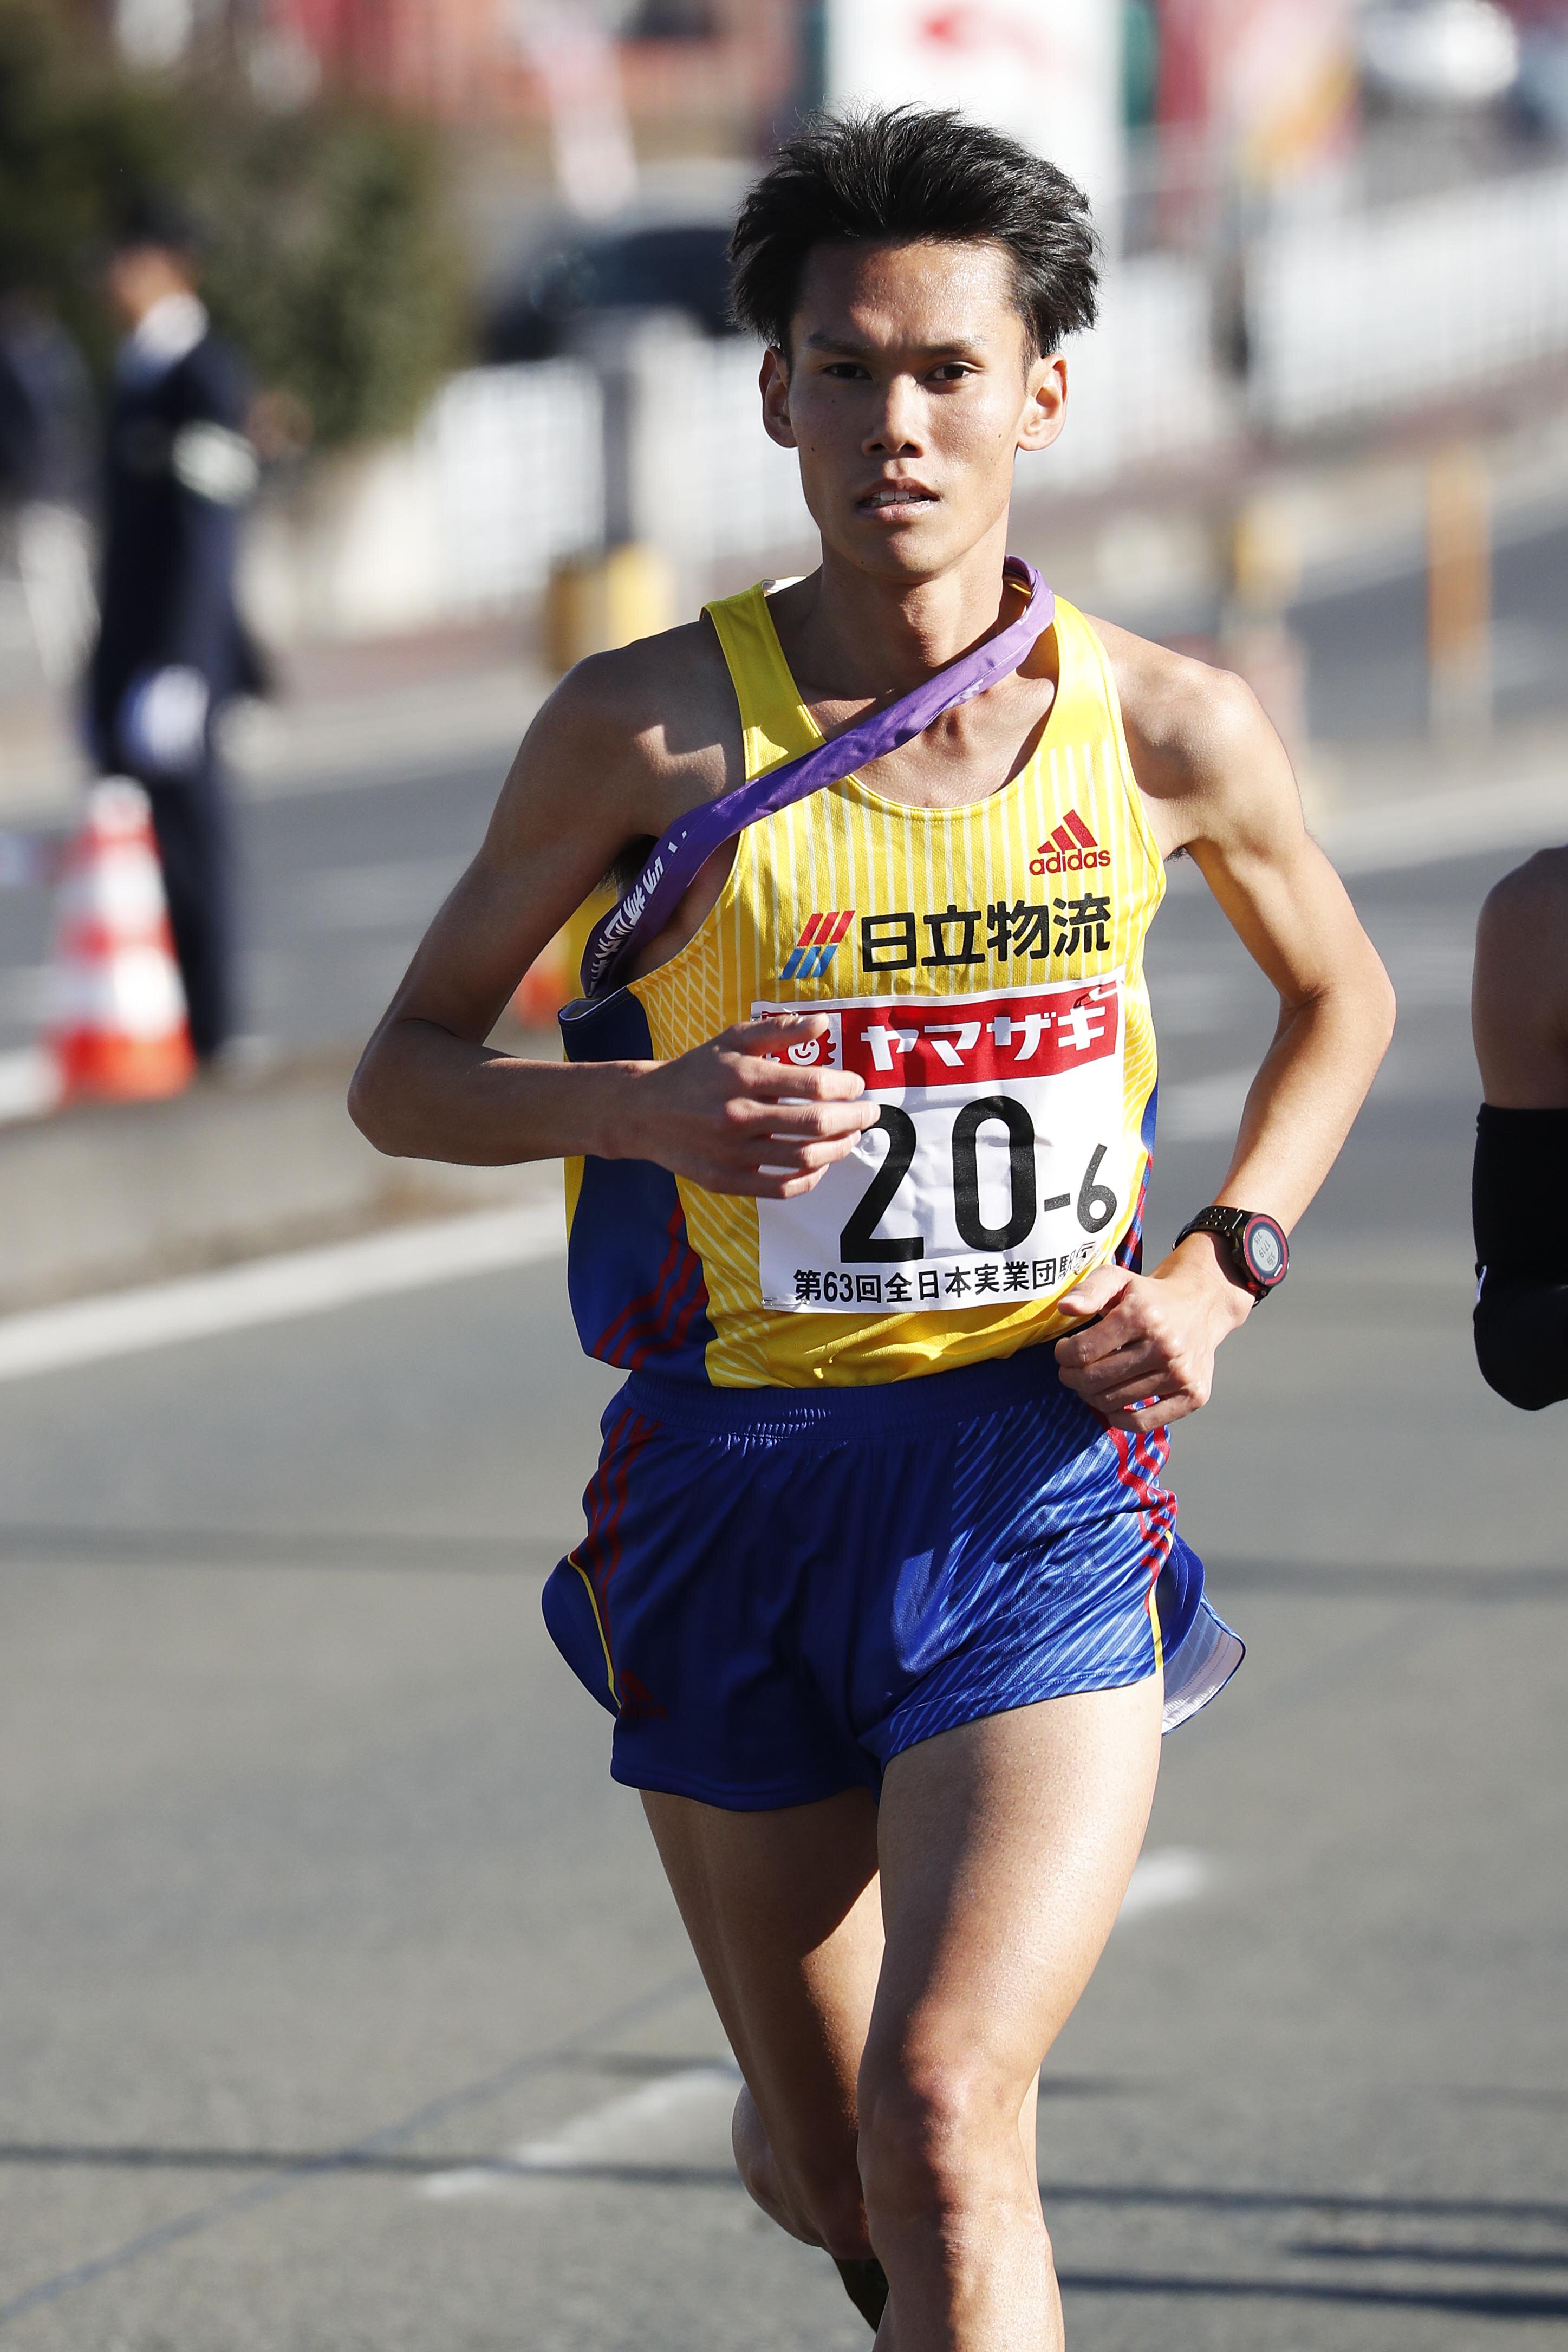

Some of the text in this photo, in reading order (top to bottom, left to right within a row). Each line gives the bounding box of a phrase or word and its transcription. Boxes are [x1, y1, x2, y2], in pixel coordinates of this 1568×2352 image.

[1029, 847, 1111, 876] adidas
[861, 893, 1111, 972] 日立物流
[861, 1004, 1106, 1071] ヤマザキ
